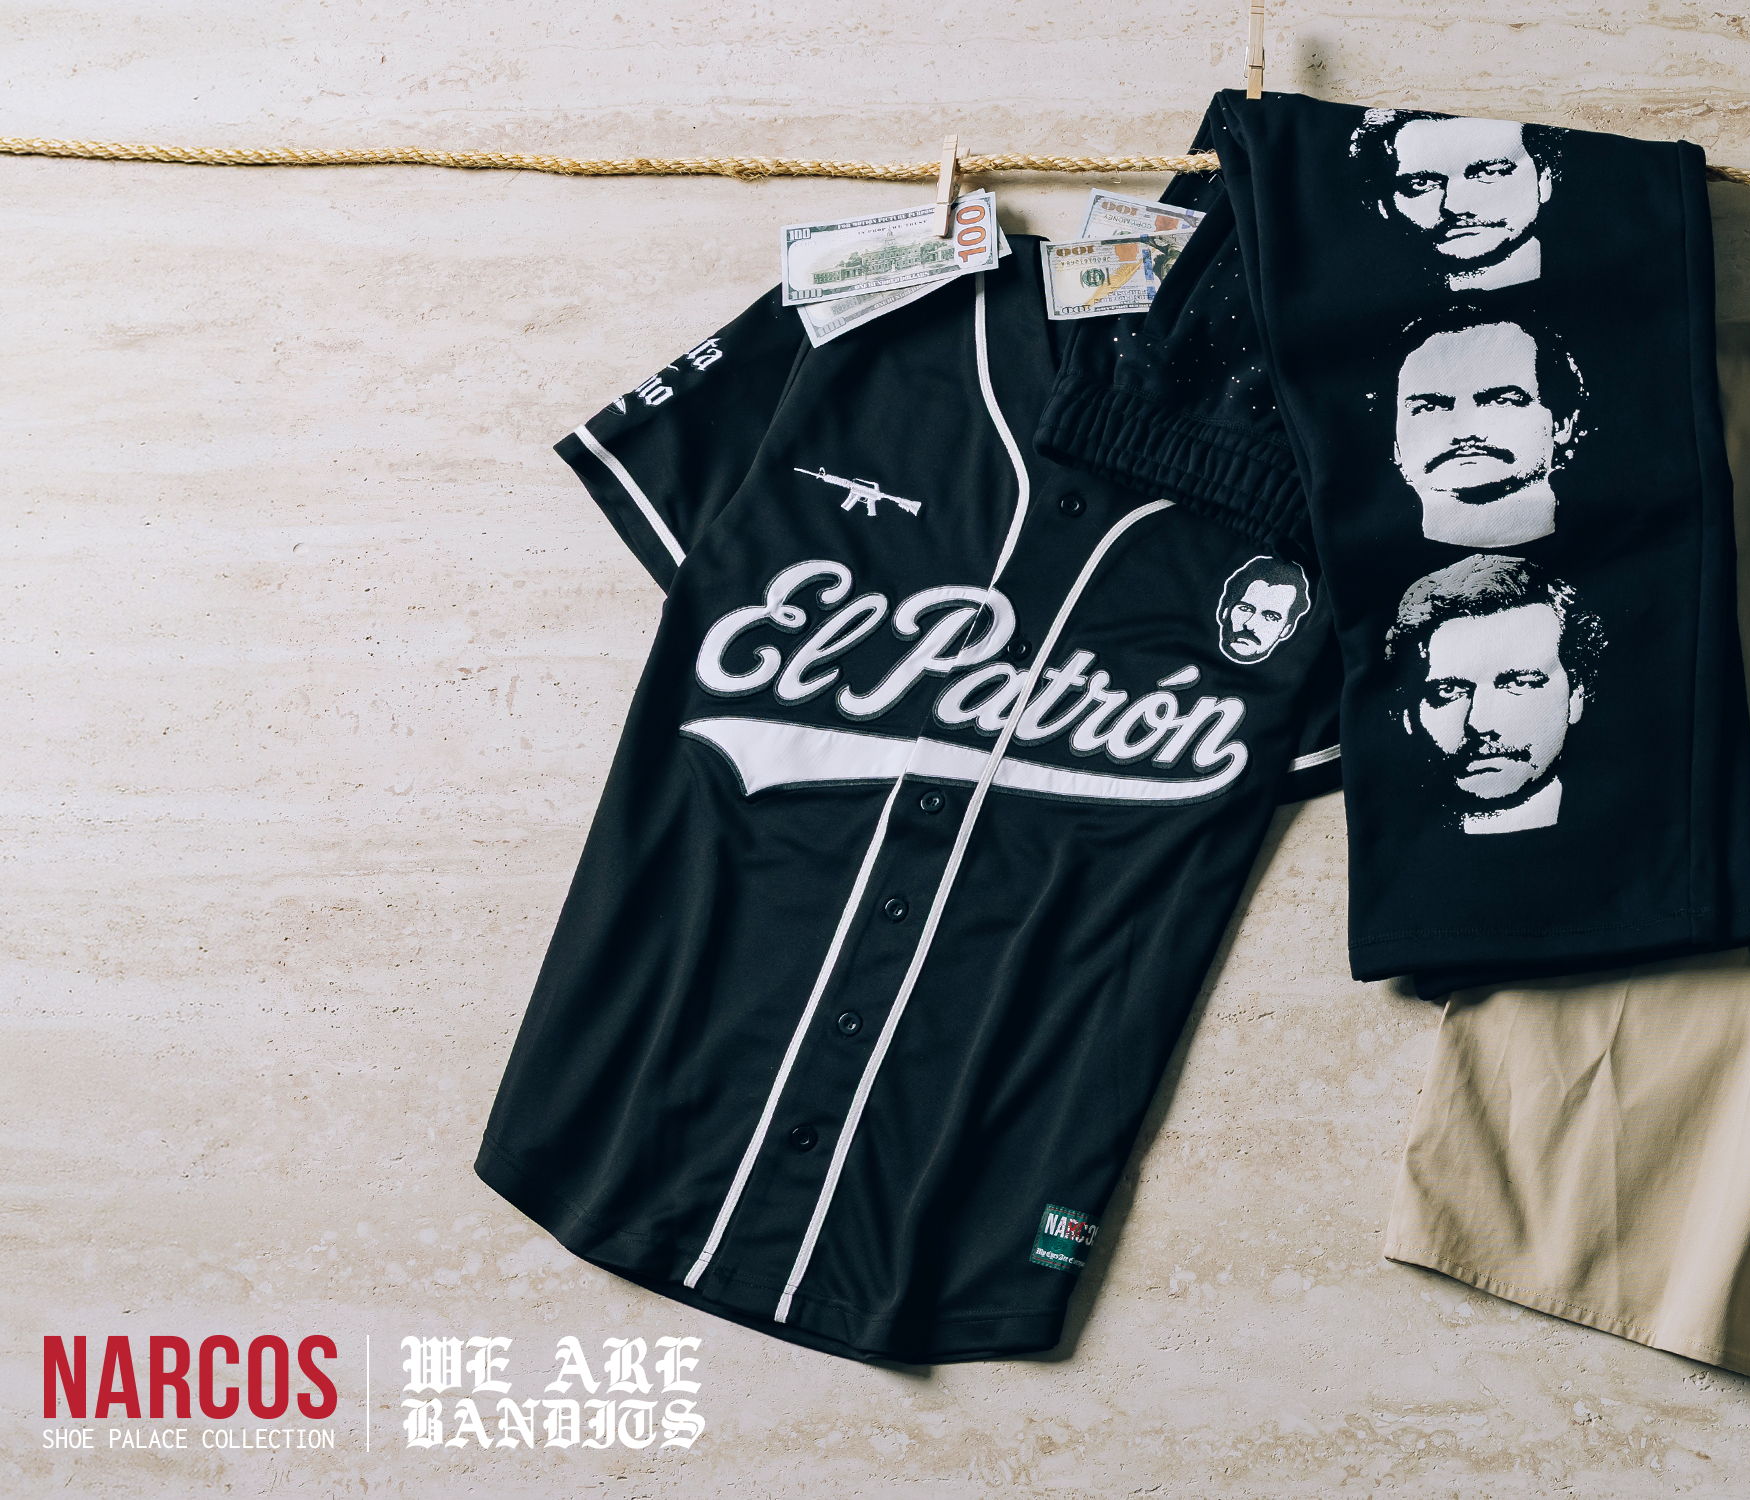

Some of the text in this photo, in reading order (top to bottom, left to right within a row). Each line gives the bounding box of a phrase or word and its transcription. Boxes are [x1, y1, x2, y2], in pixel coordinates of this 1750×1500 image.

[1101, 201, 1139, 216] 100
[787, 228, 812, 241] 100
[956, 205, 987, 263] 100
[1056, 245, 1095, 257] 100
[695, 559, 1250, 772] El Patrón
